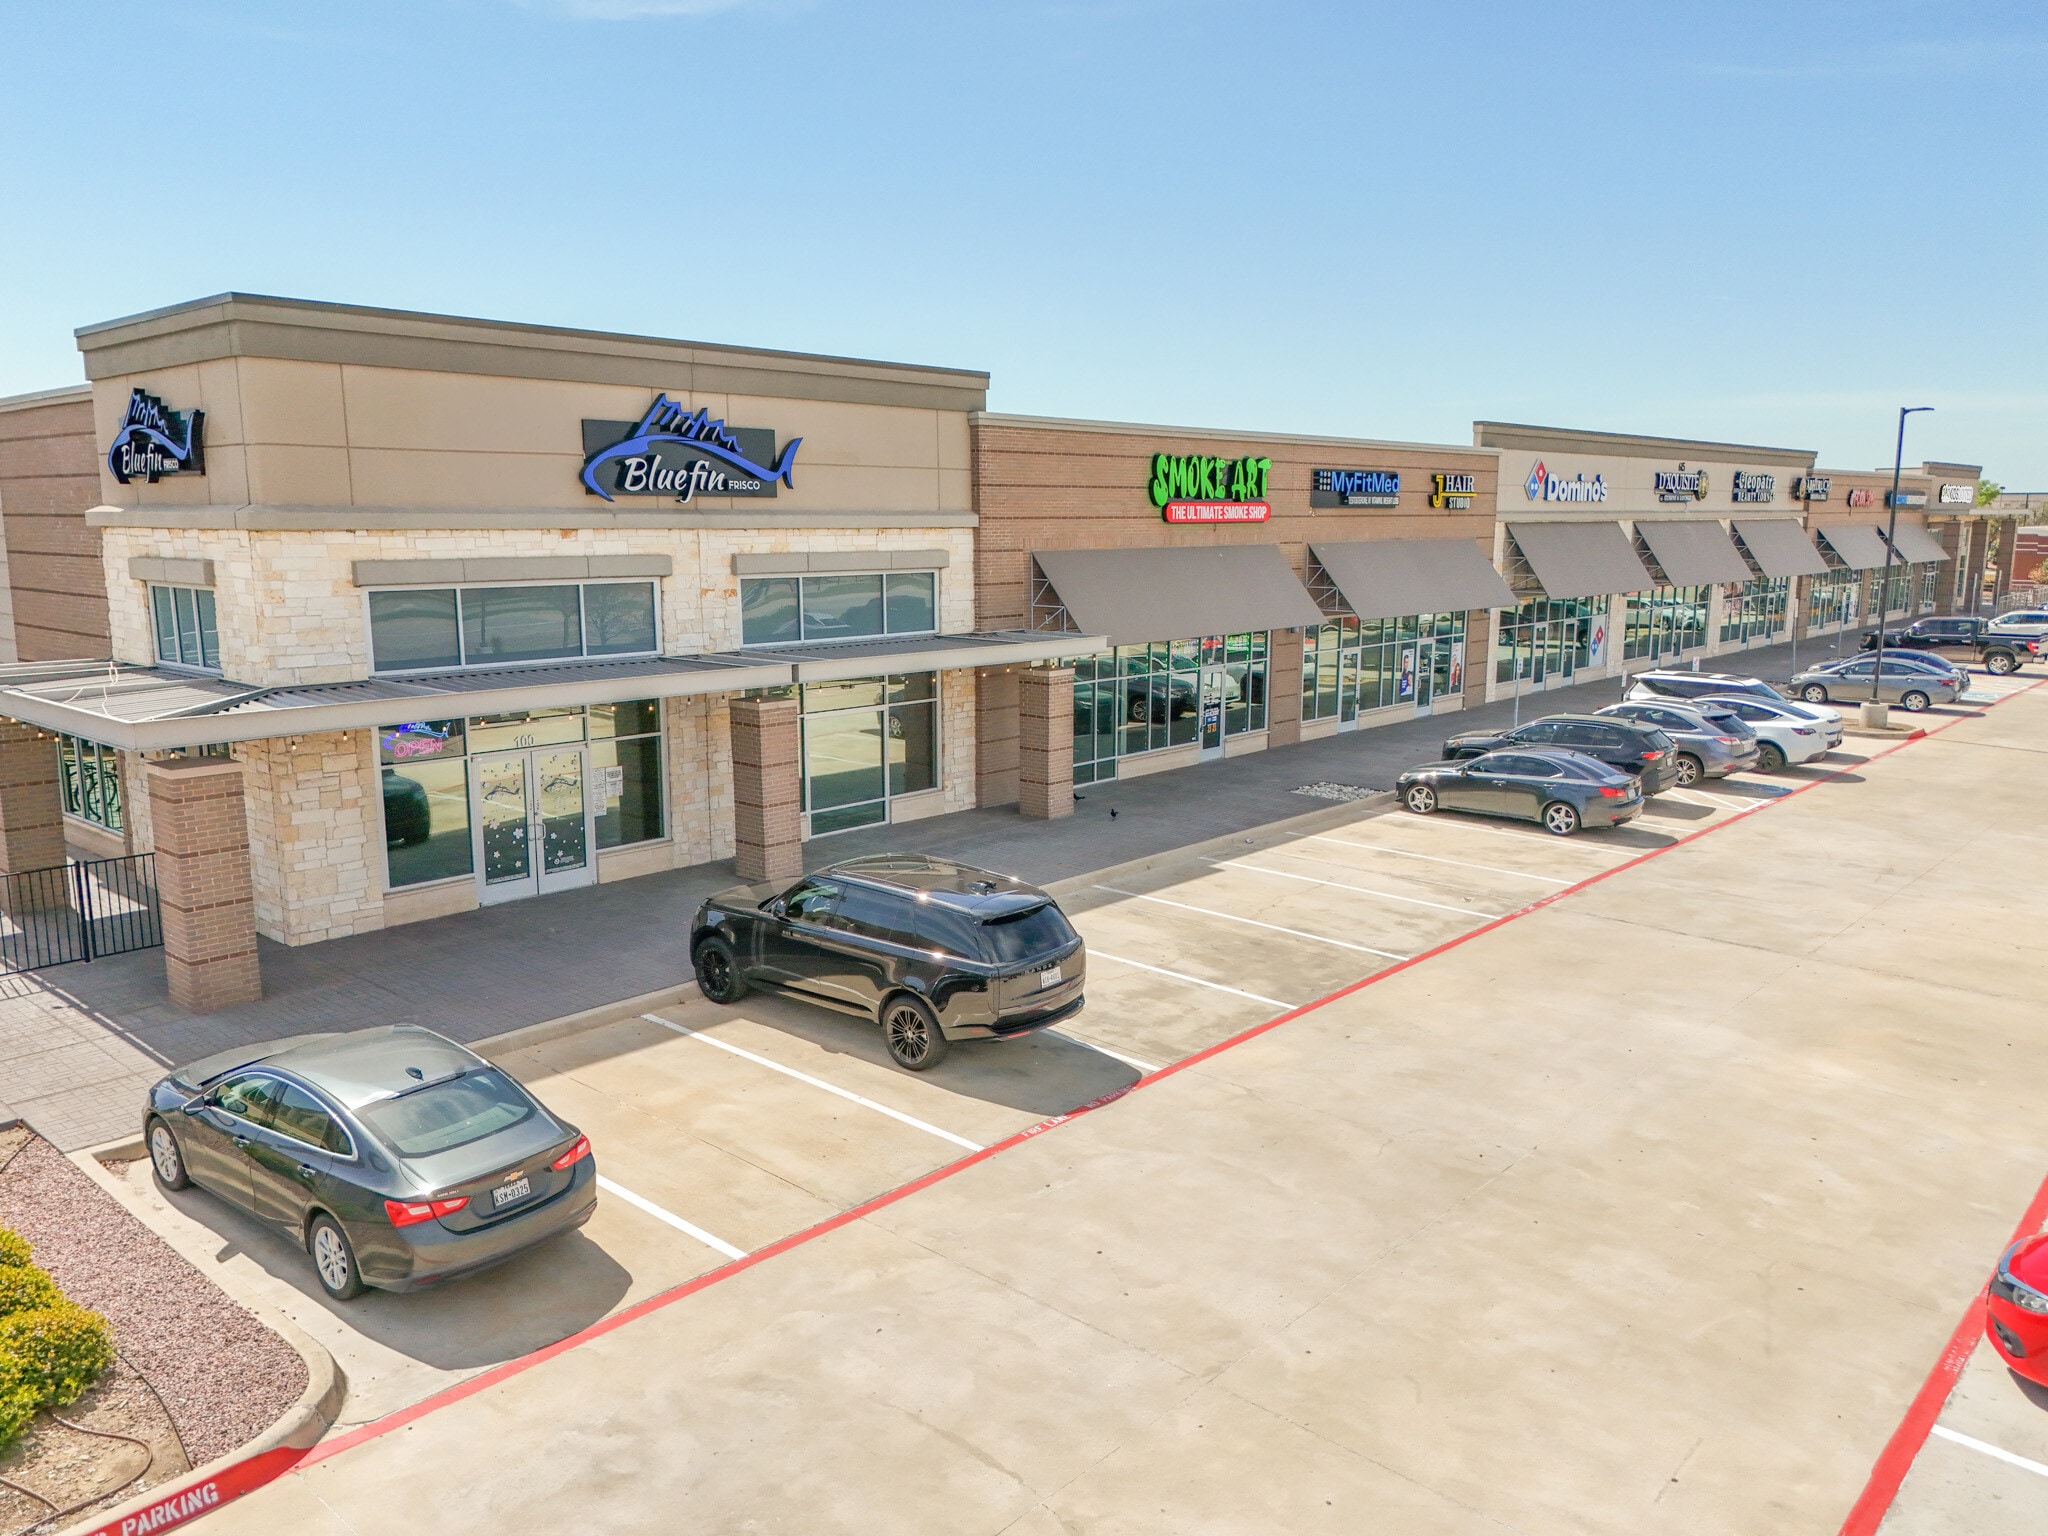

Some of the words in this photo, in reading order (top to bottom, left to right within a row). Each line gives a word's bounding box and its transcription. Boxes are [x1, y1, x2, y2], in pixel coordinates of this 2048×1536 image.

[121, 441, 162, 483] Bluefin
[624, 454, 724, 503] Bluefin
[729, 480, 761, 490] FRISCO
[1153, 454, 1226, 506] SMOKE
[1231, 457, 1272, 502] ART
[1331, 471, 1400, 496] MyFitMed
[1445, 475, 1475, 492] HAIR
[1547, 473, 1608, 502] Domino's
[1171, 506, 1187, 519] THE
[1187, 506, 1224, 519] ULTIMATE
[1224, 506, 1249, 519] SMOKE
[1249, 506, 1267, 519] SHOP
[394, 738, 443, 758] OPEN
[514, 735, 534, 747] 100
[1020, 1126, 1044, 1138] FIRE
[1043, 1114, 1071, 1126] LANE
[121, 1482, 219, 1536] PARKING
